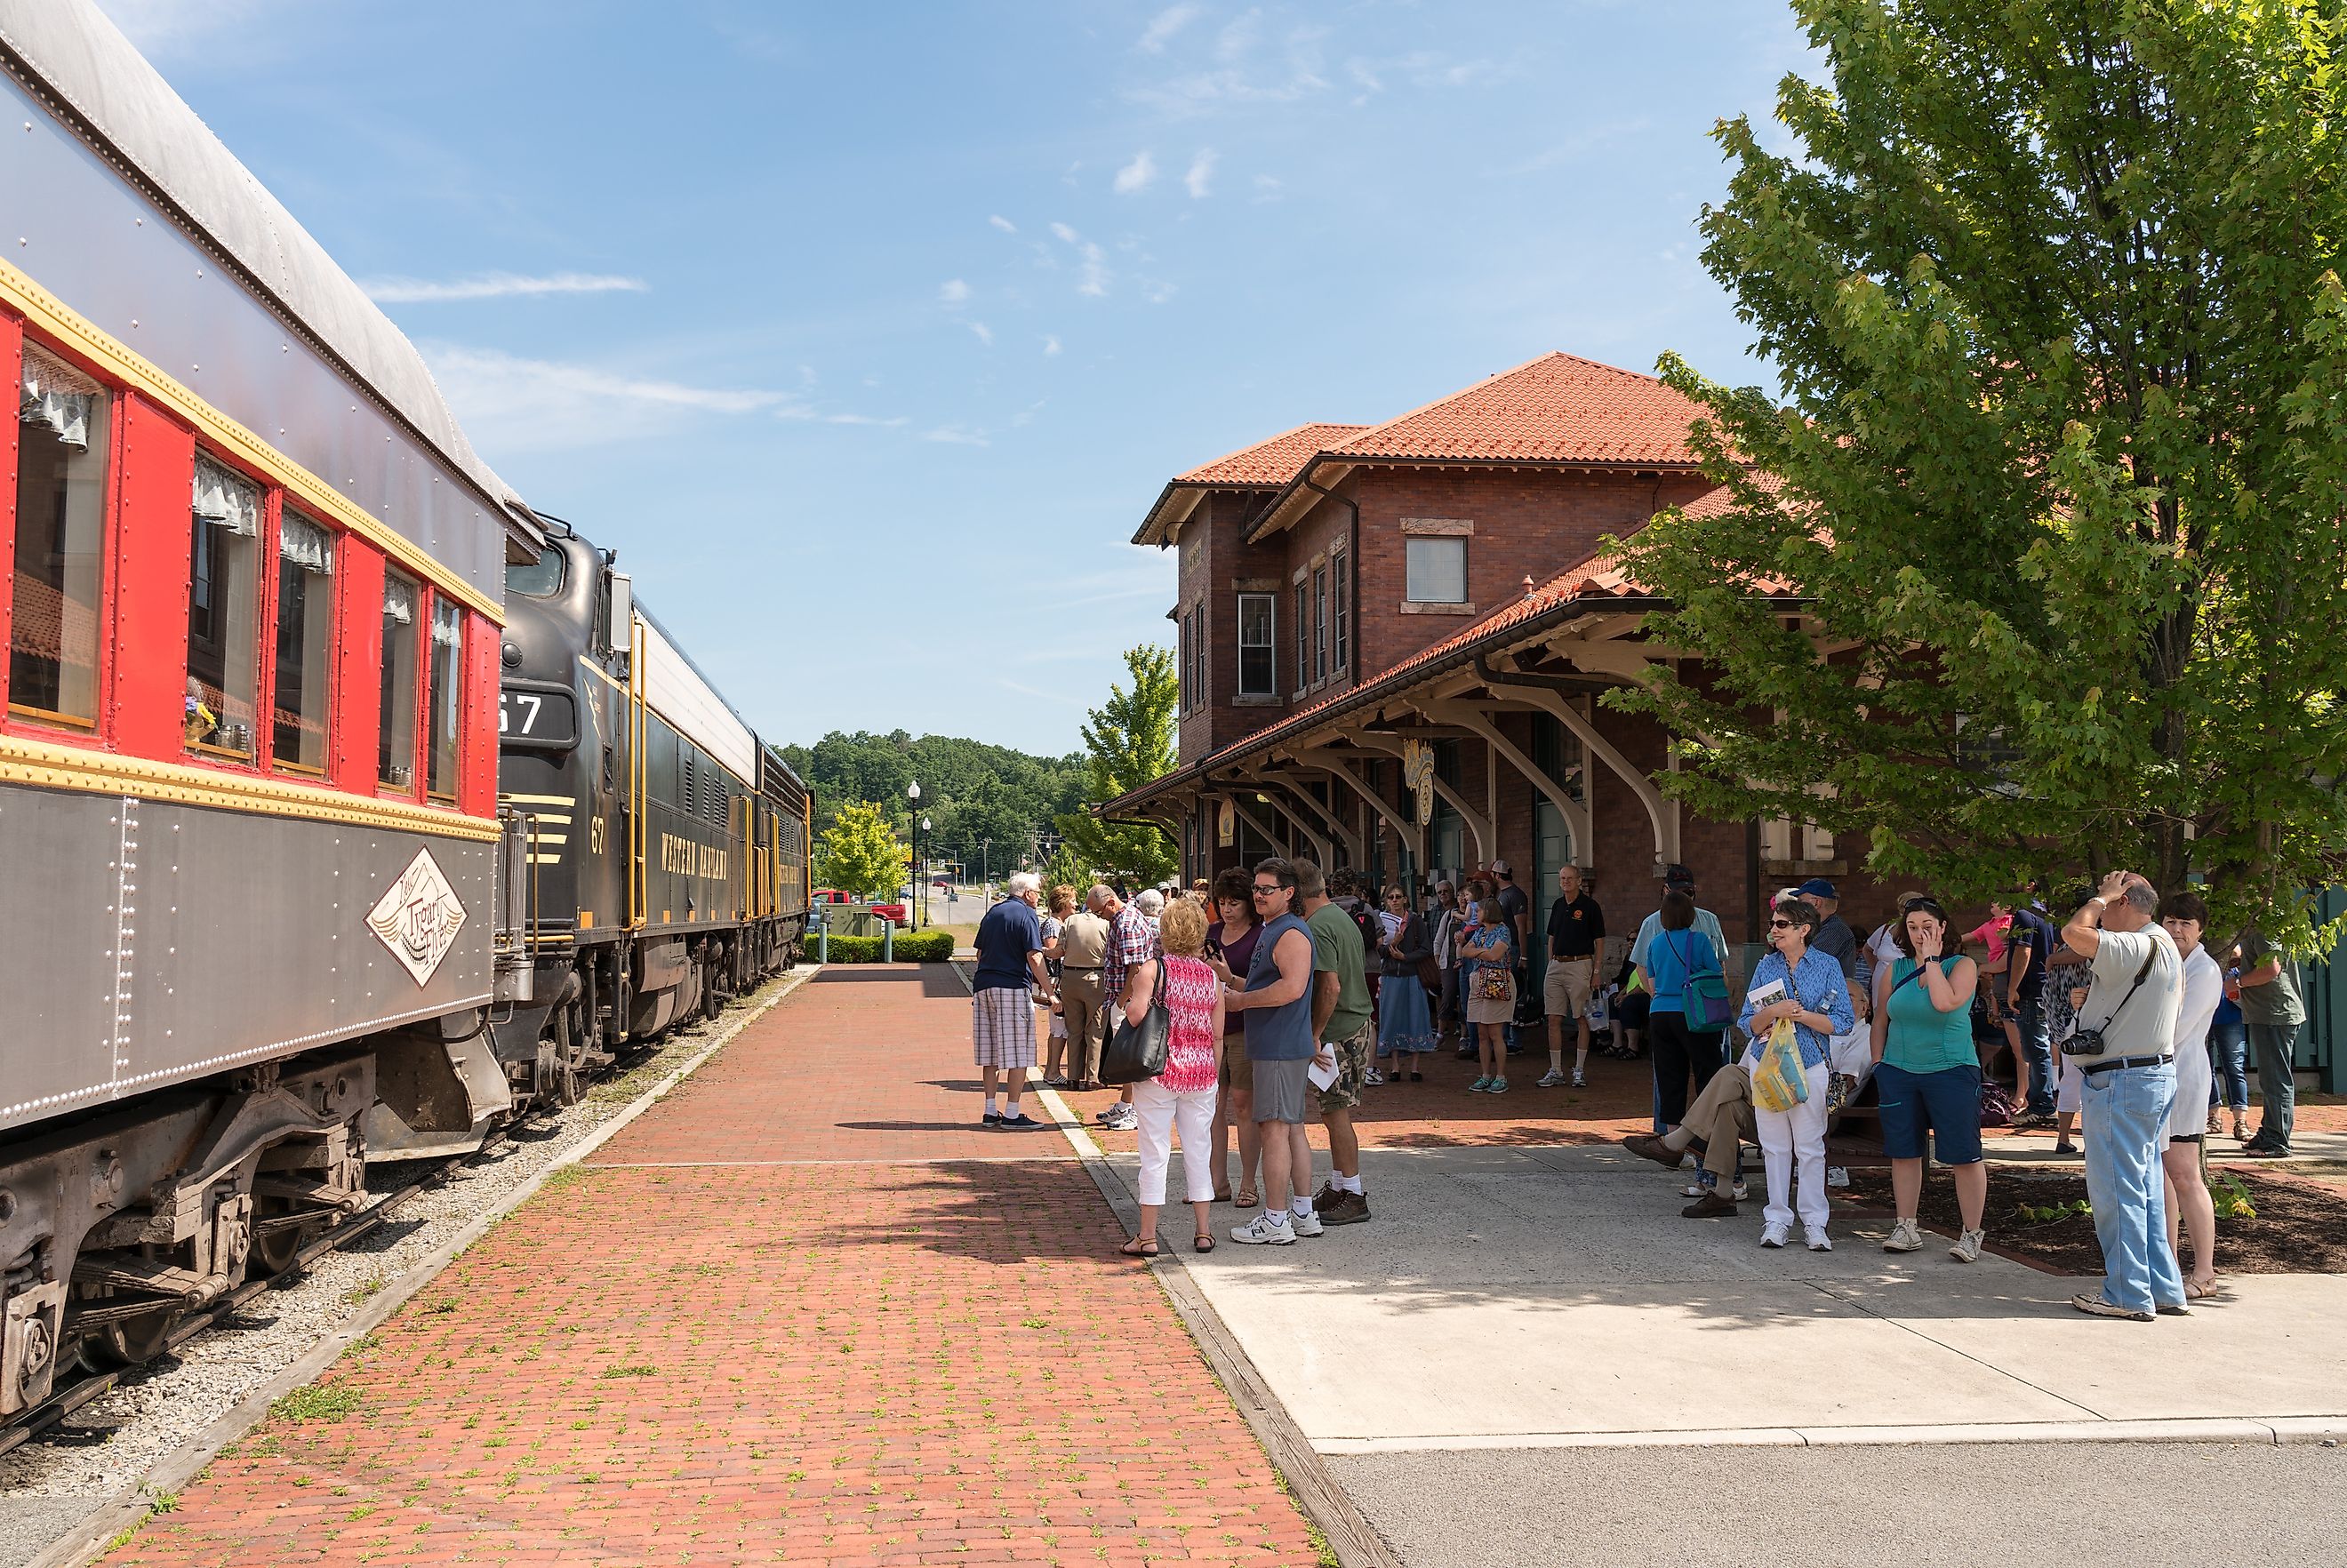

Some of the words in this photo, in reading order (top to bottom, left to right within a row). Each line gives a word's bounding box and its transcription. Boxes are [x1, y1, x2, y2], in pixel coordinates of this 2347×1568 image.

[591, 815, 605, 855] 67
[661, 832, 696, 876] WESTERN
[406, 893, 448, 945] Tygart
